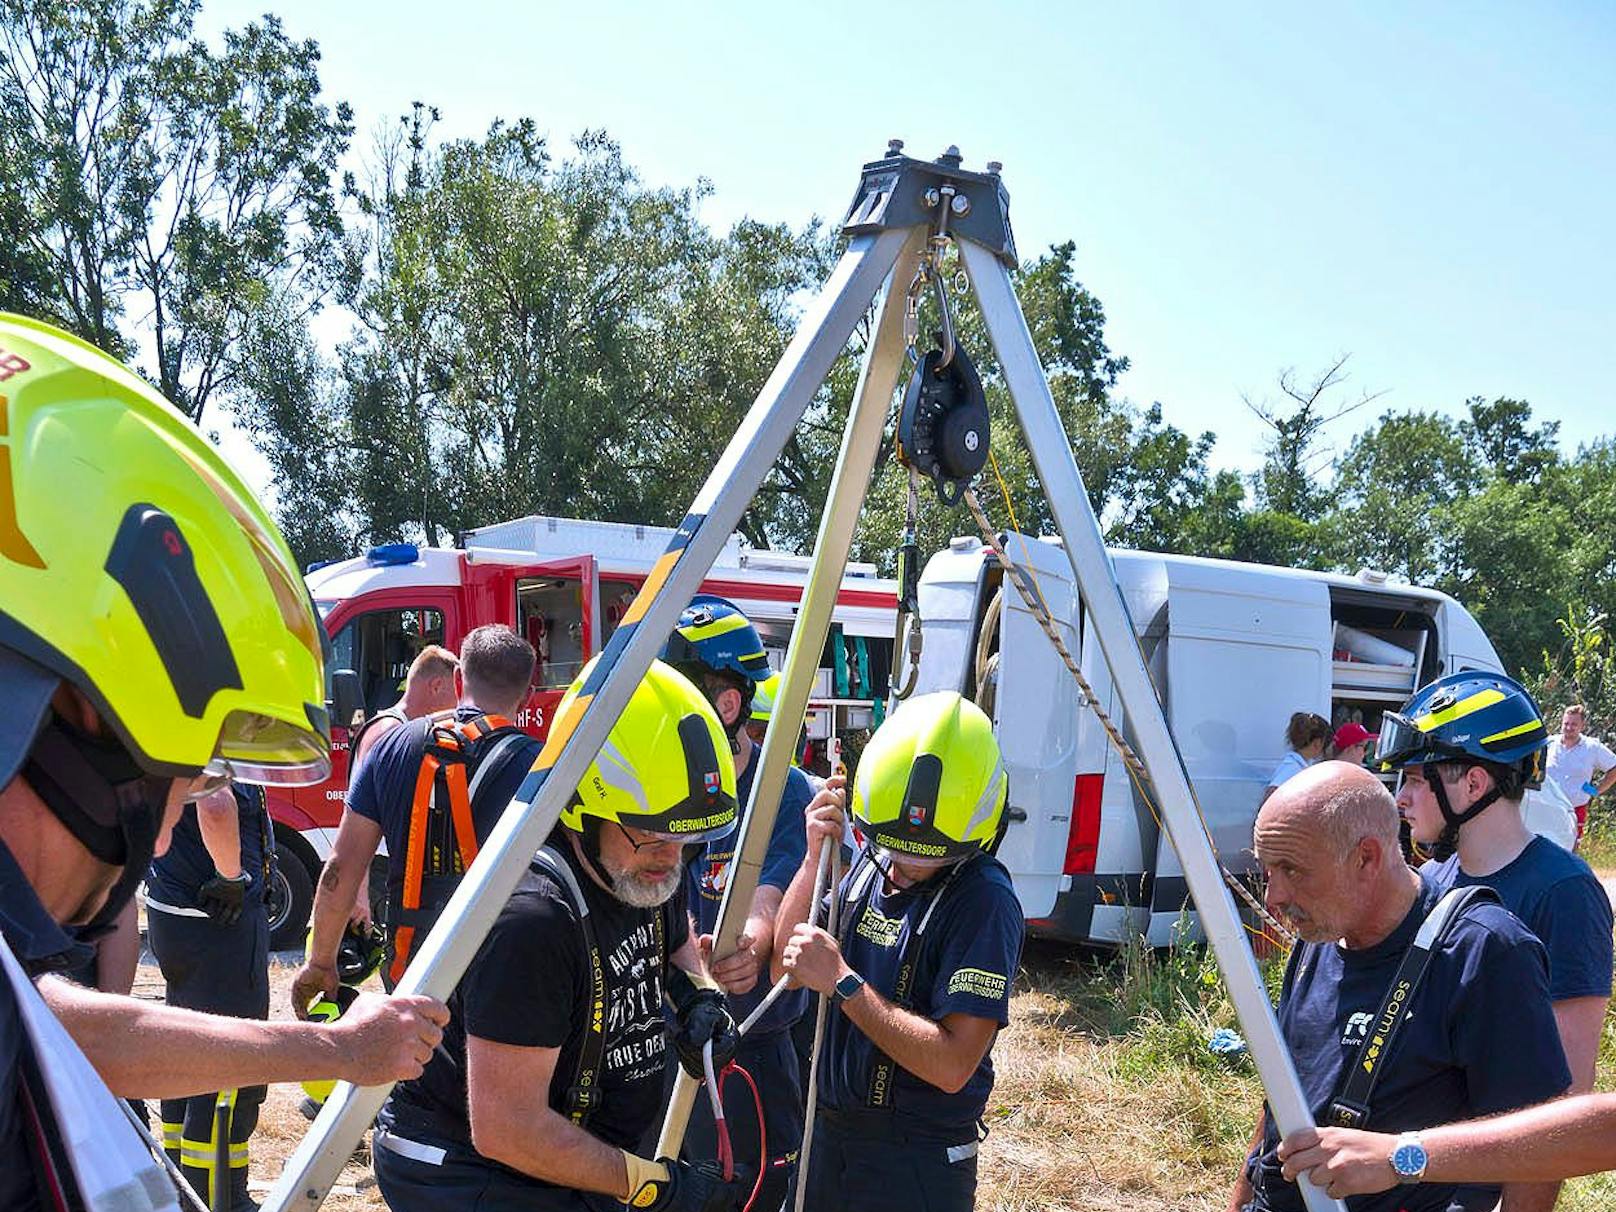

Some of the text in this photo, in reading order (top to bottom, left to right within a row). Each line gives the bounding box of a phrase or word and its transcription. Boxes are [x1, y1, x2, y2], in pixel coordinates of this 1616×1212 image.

[668, 807, 734, 833] OBERWALTERSDORF
[875, 832, 947, 857] OBERWALTERSDORF
[949, 973, 1006, 990] FEUERWEHR
[606, 1042, 643, 1071] TRUE
